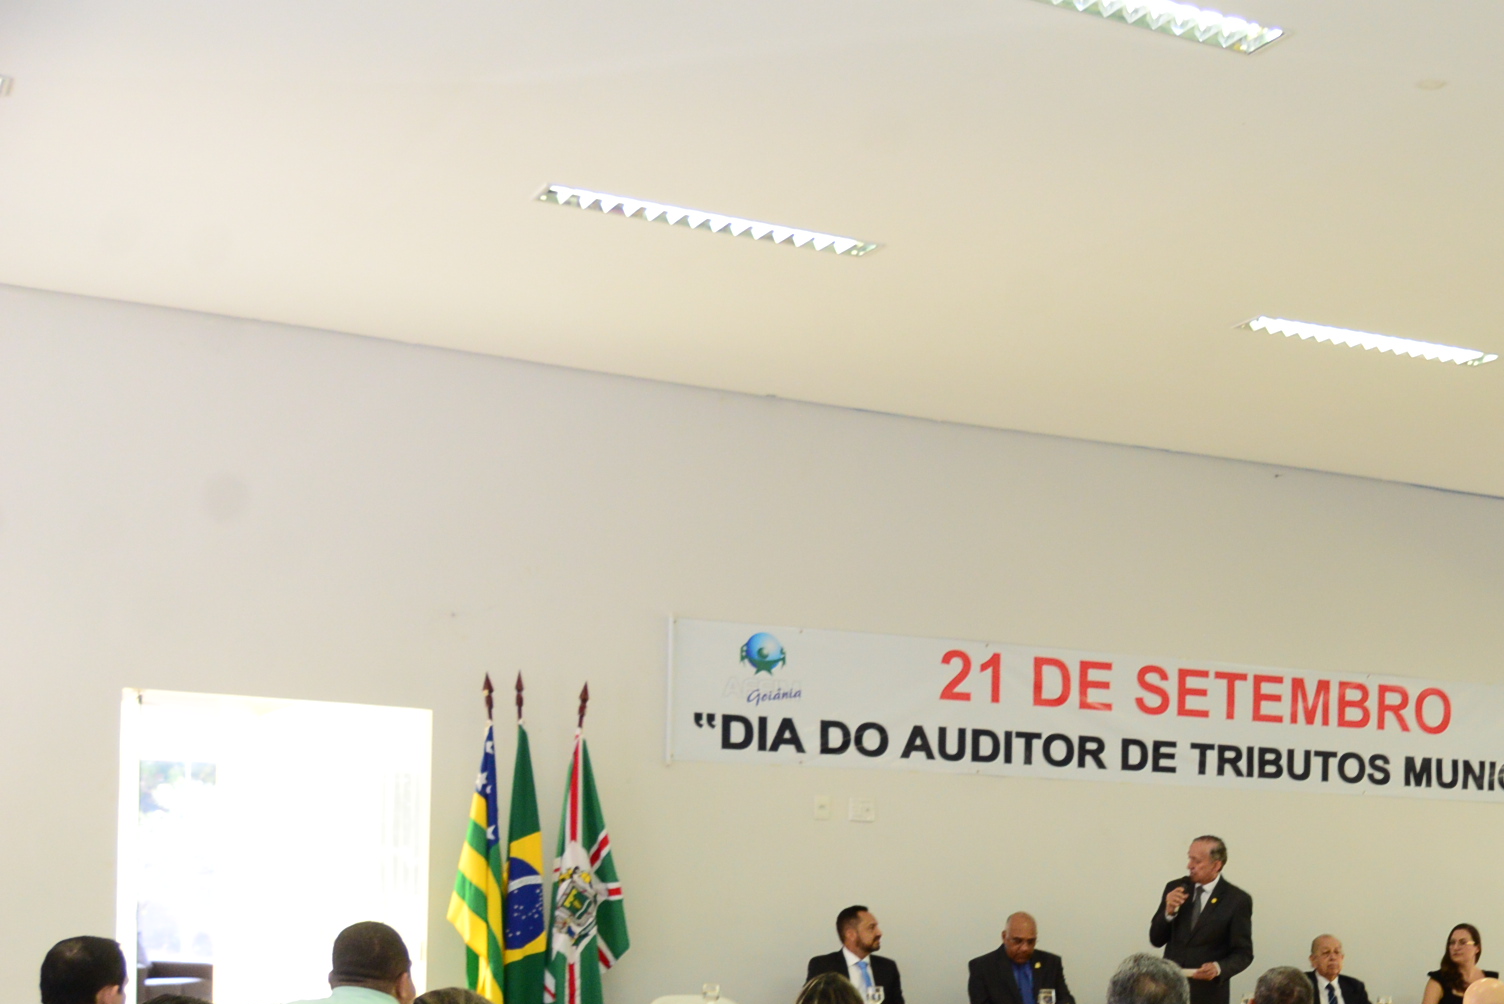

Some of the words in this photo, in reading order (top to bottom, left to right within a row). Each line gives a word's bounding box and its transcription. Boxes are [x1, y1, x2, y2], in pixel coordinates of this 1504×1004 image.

[939, 650, 1002, 704] 21
[1032, 656, 1113, 712] DE
[1134, 664, 1452, 735] SETEMBRO
[693, 712, 806, 754] “DIA
[819, 720, 889, 758] DO
[900, 725, 1108, 770] AUDITOR
[1120, 738, 1178, 774] DE
[1190, 742, 1391, 786] TRIBUTOS
